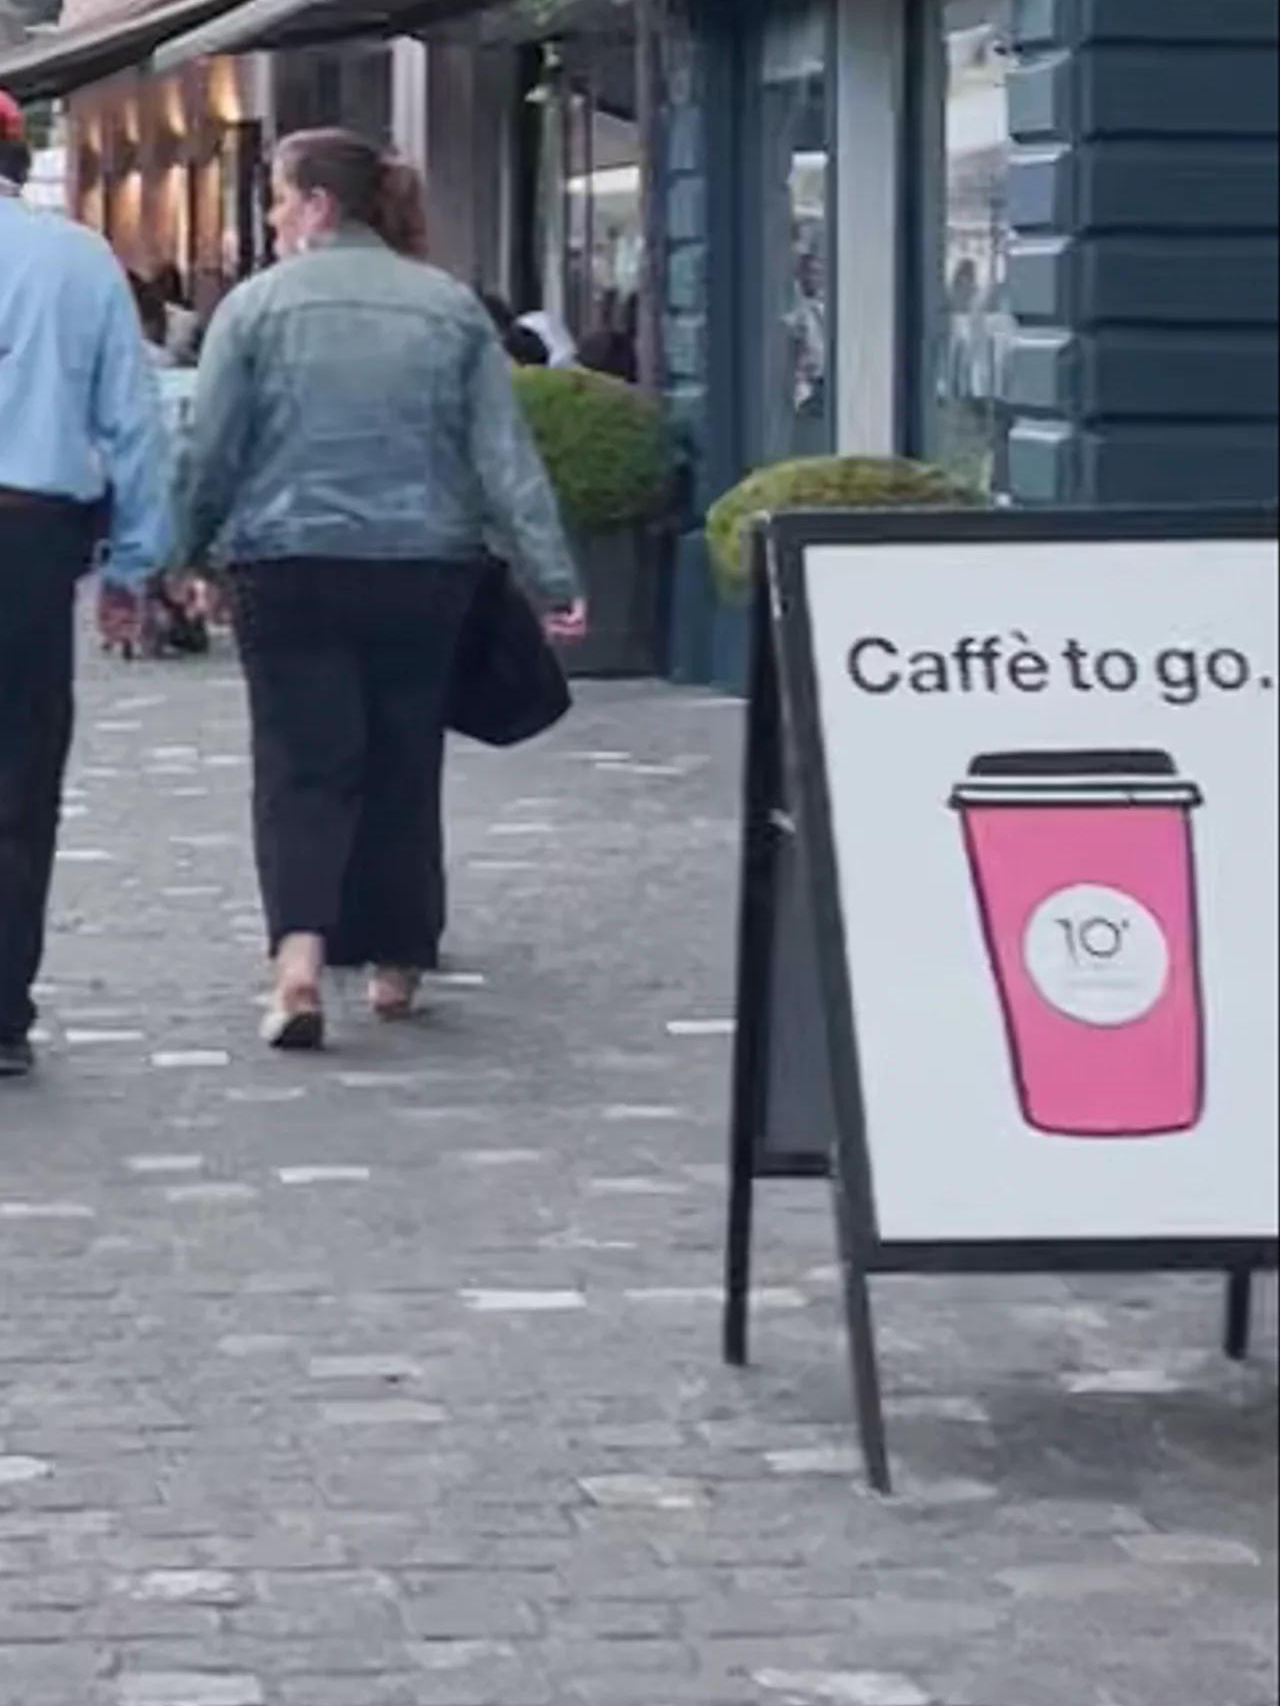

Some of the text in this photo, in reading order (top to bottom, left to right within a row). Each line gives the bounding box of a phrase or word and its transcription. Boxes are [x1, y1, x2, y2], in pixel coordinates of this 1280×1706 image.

[846, 629, 1273, 707] Caffè to go.
